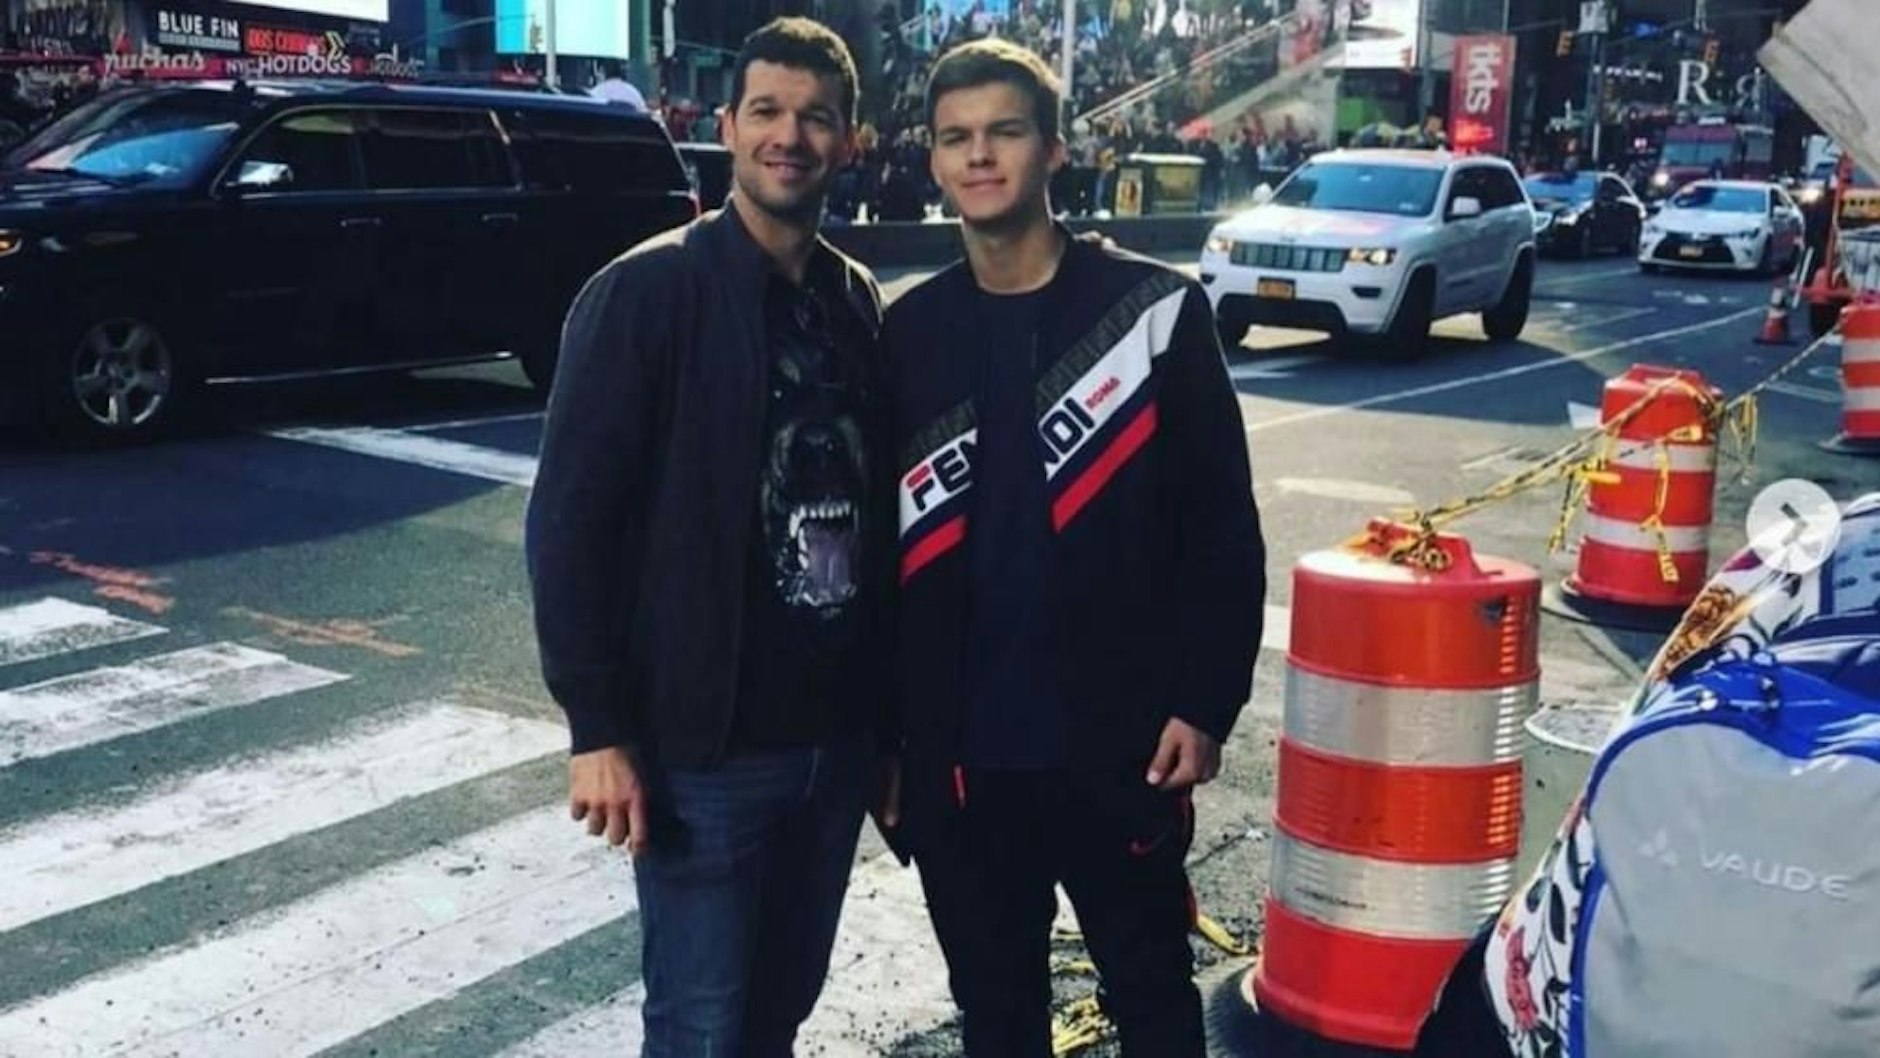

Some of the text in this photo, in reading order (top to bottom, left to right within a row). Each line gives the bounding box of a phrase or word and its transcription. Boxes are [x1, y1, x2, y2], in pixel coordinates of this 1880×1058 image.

[158, 10, 239, 38] BLUE FIN
[259, 53, 351, 74] HOTDOGS
[1466, 44, 1500, 114] tkts
[1677, 59, 1711, 105] R
[1701, 849, 1851, 900] VAUDE
